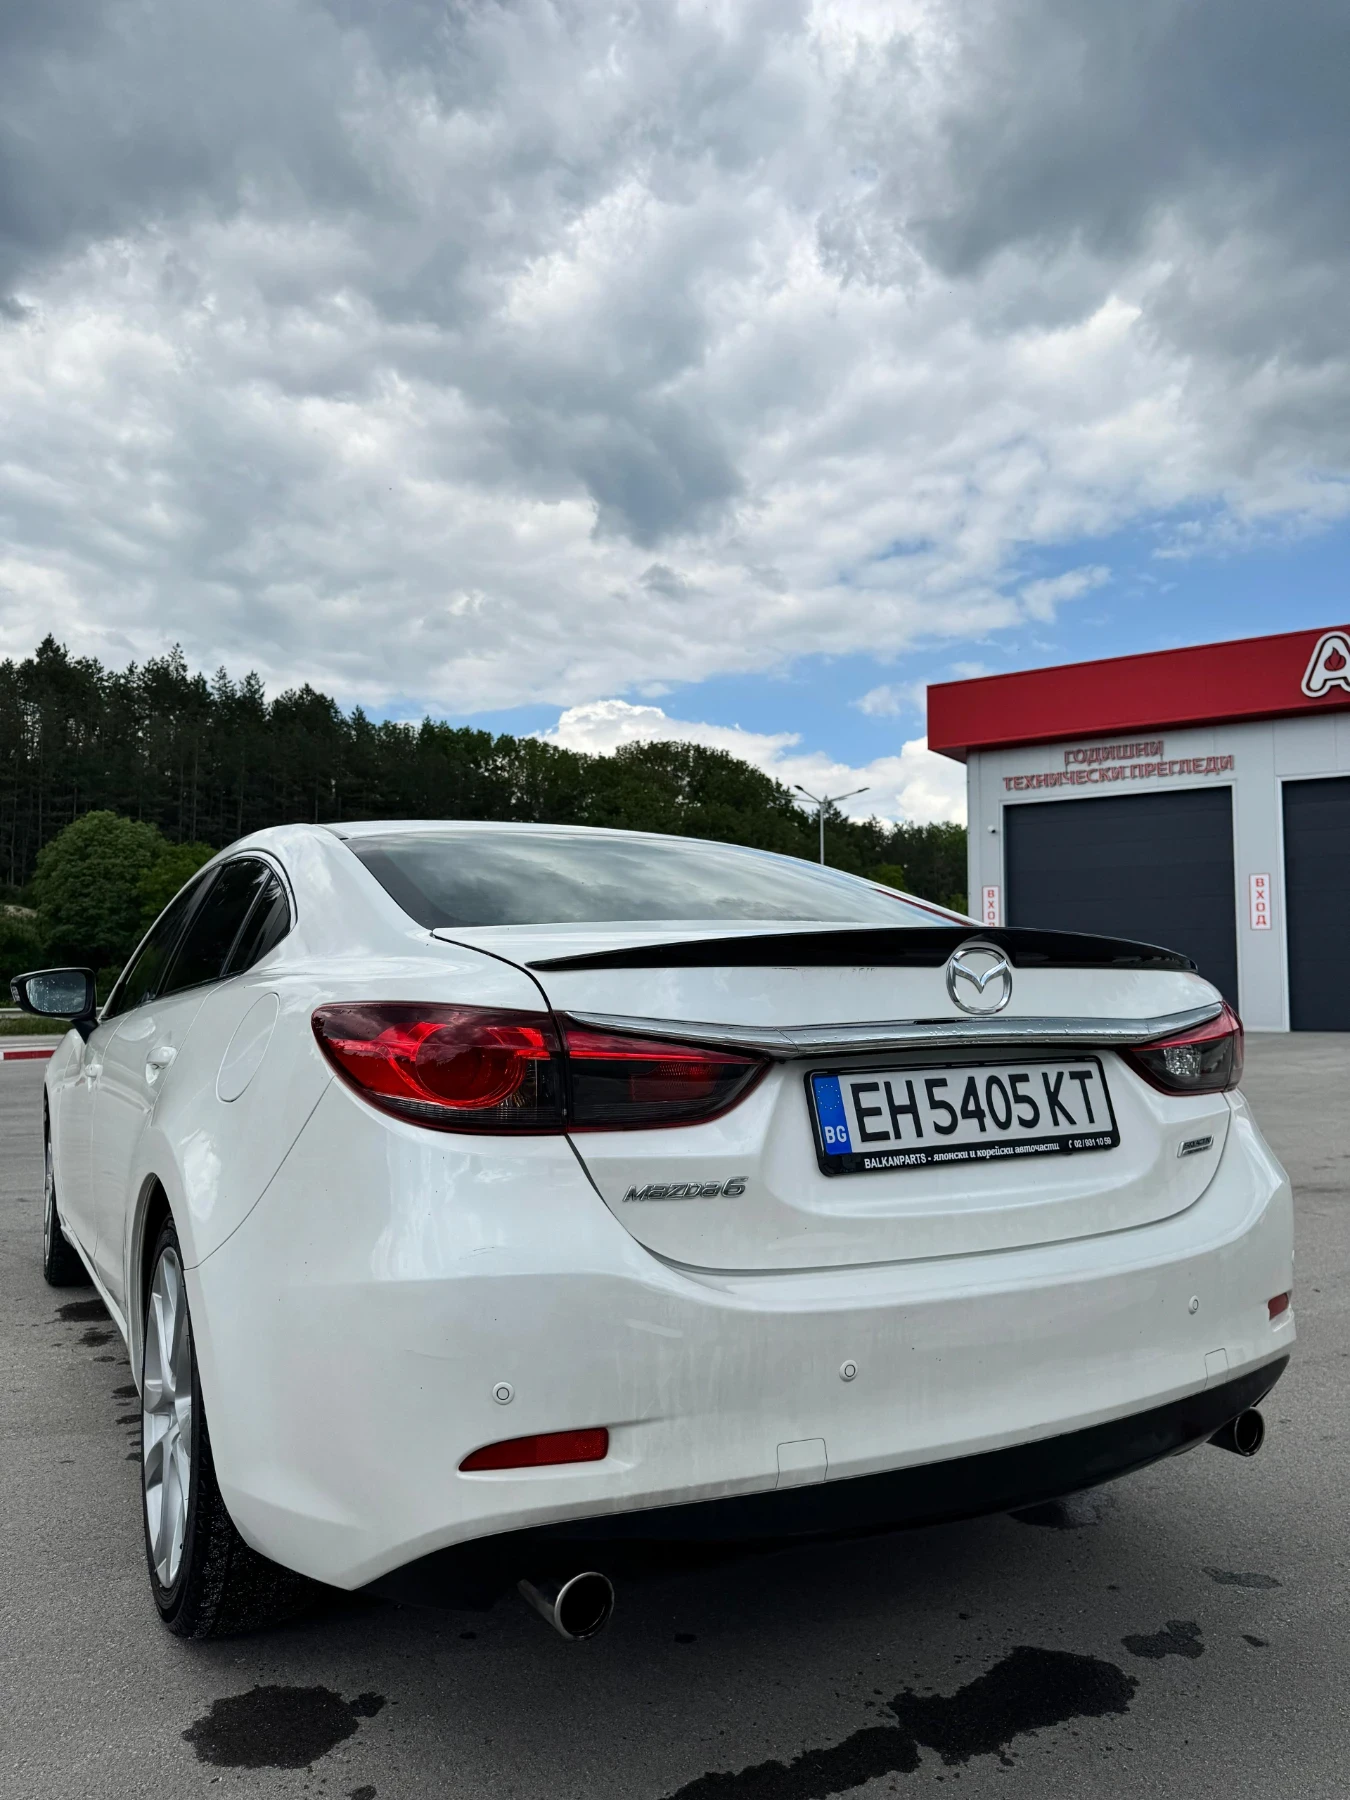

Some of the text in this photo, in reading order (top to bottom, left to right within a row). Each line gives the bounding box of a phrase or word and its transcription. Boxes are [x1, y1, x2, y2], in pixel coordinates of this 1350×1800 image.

[1064, 740, 1164, 765] ГОДИШНИ
[1002, 755, 1234, 791] ТЕХНИЧЕСКИ ПРЕГЛЕДИ
[1256, 878, 1267, 926] ВХОД
[824, 1125, 847, 1143] BG
[864, 1153, 927, 1169] BALKANPARTS
[933, 1151, 968, 1162] японски
[976, 1145, 1014, 1159] корейски
[1015, 1142, 1060, 1154] авточасти
